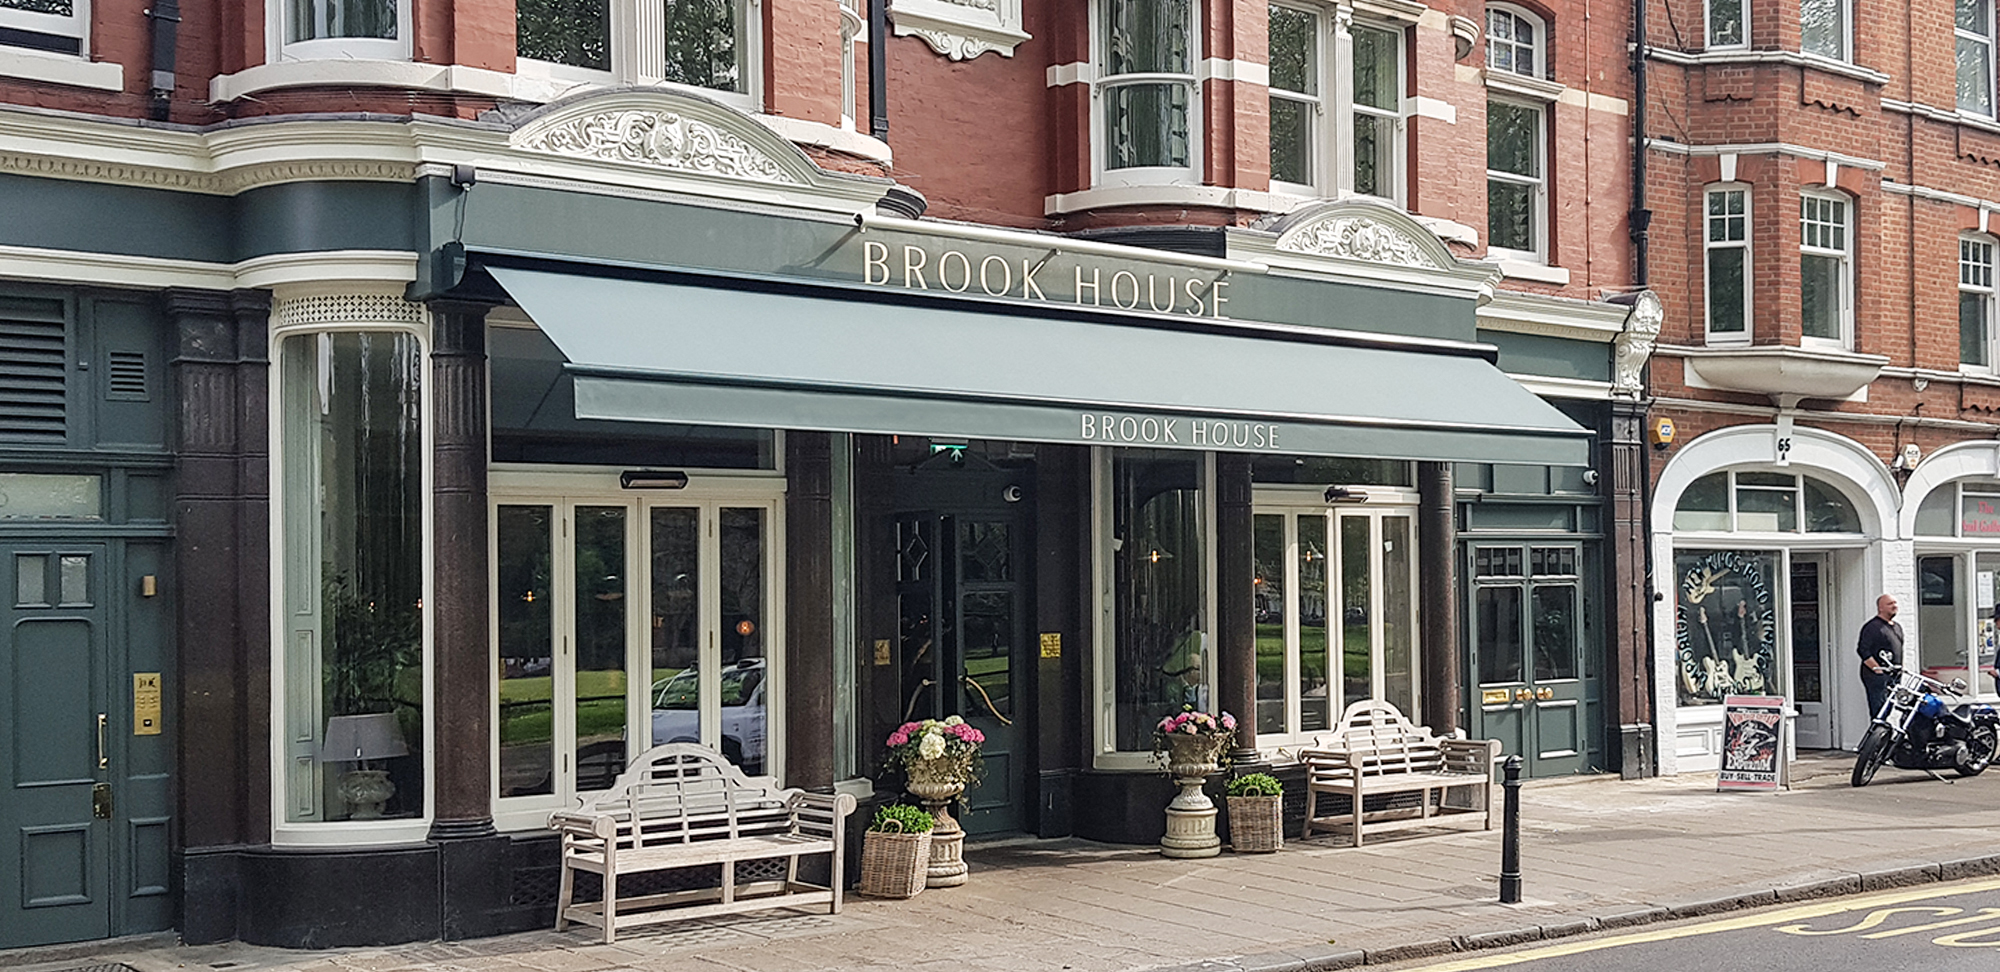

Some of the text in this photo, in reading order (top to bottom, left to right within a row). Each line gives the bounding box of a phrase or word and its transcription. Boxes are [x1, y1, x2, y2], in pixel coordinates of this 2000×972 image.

[863, 240, 1231, 320] BROOK HOUSE
[1081, 413, 1280, 449] BROOK HOUSE
[1777, 438, 1791, 452] 65
[1978, 501, 1994, 514] The
[1743, 563, 1770, 605] ROAD
